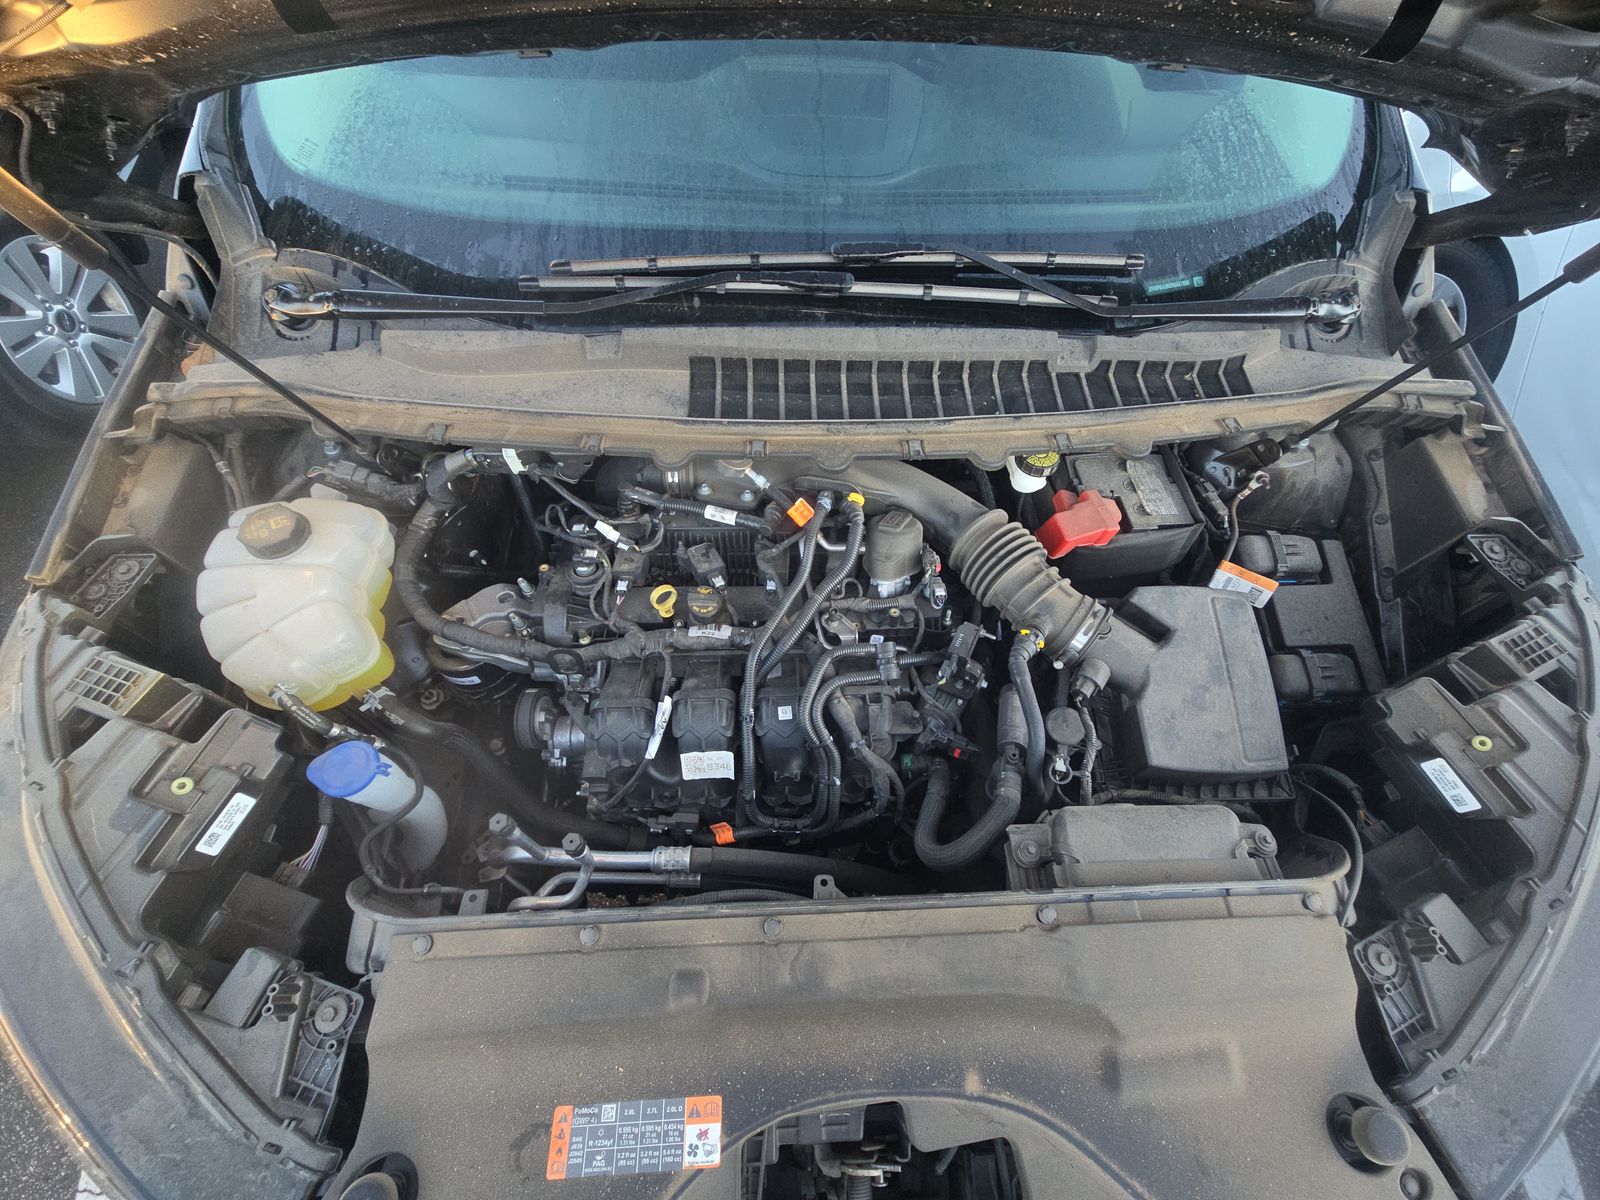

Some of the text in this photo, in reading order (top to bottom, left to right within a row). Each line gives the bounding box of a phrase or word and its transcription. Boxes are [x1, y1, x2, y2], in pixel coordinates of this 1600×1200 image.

[574, 1107, 599, 1115] FoMoCo
[572, 1116, 598, 1126] (GWP 4)
[632, 1126, 639, 1134] kg
[655, 1124, 662, 1133] kg
[677, 1123, 684, 1131] kg
[588, 1139, 614, 1147] R-1234yf
